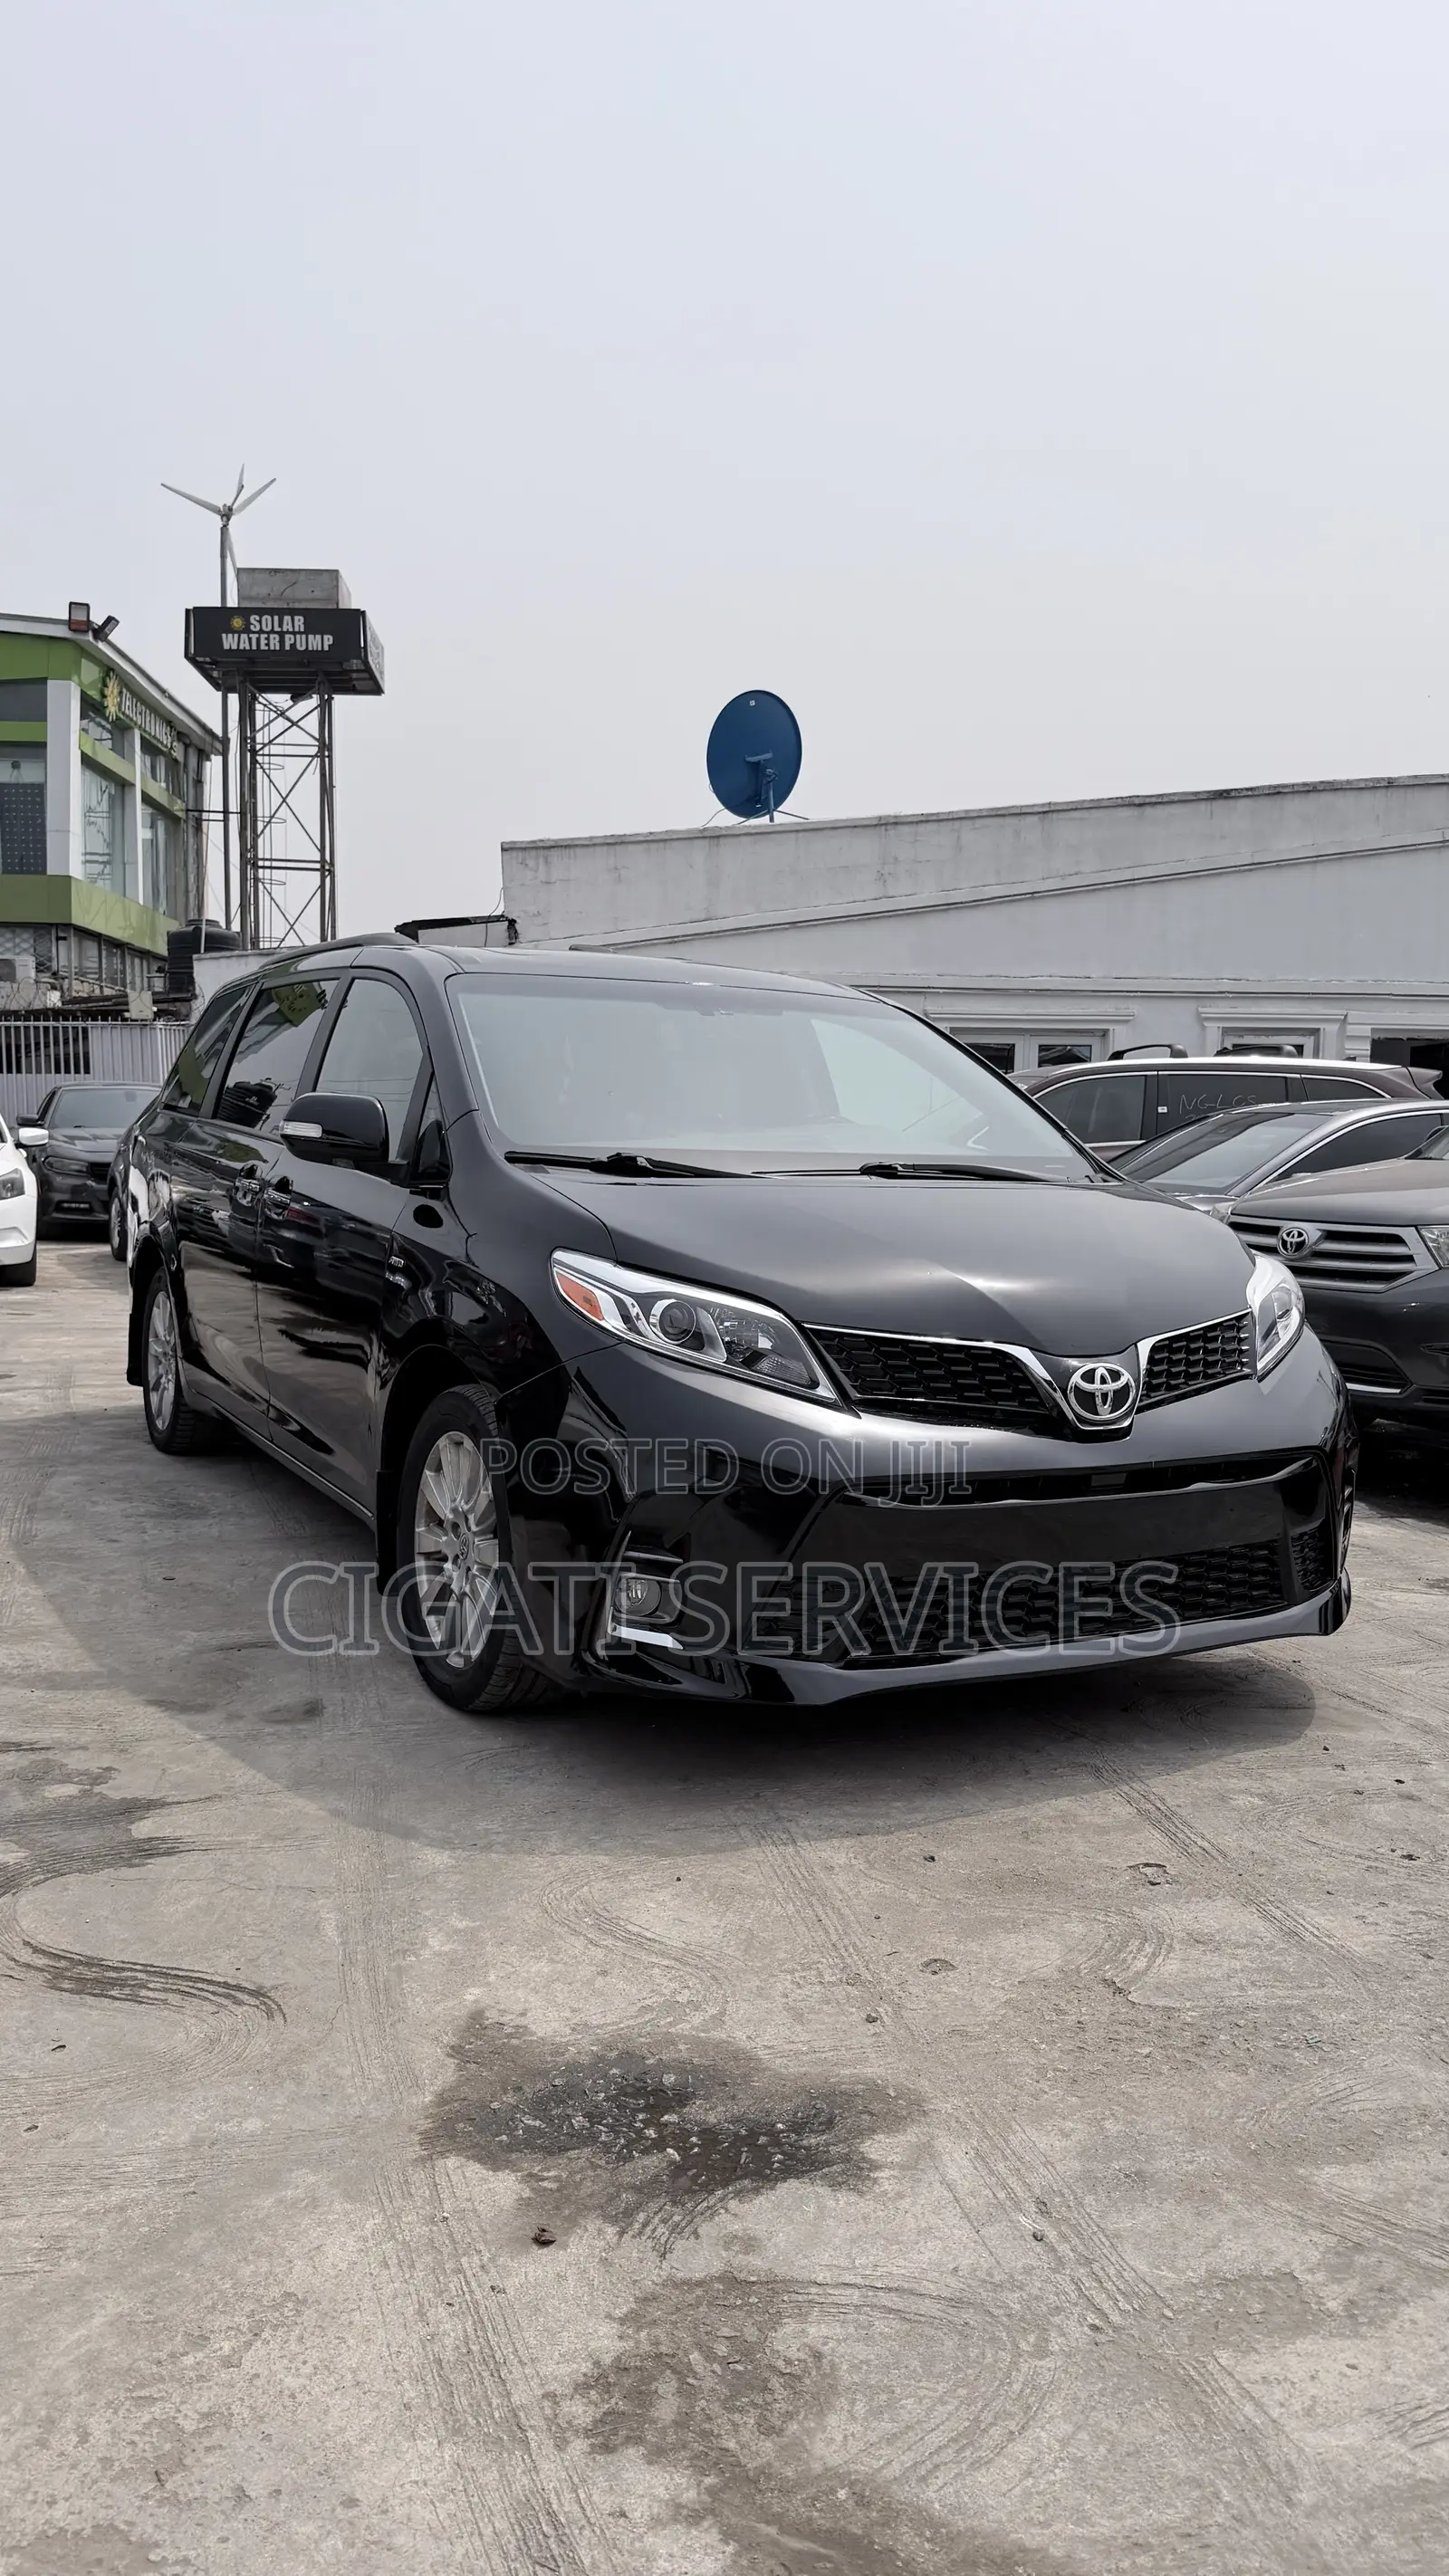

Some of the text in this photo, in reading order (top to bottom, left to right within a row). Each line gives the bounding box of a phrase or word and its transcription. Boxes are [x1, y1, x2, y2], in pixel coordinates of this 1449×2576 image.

[249, 615, 305, 632] SOLAR
[221, 633, 333, 651] WATER PUMP
